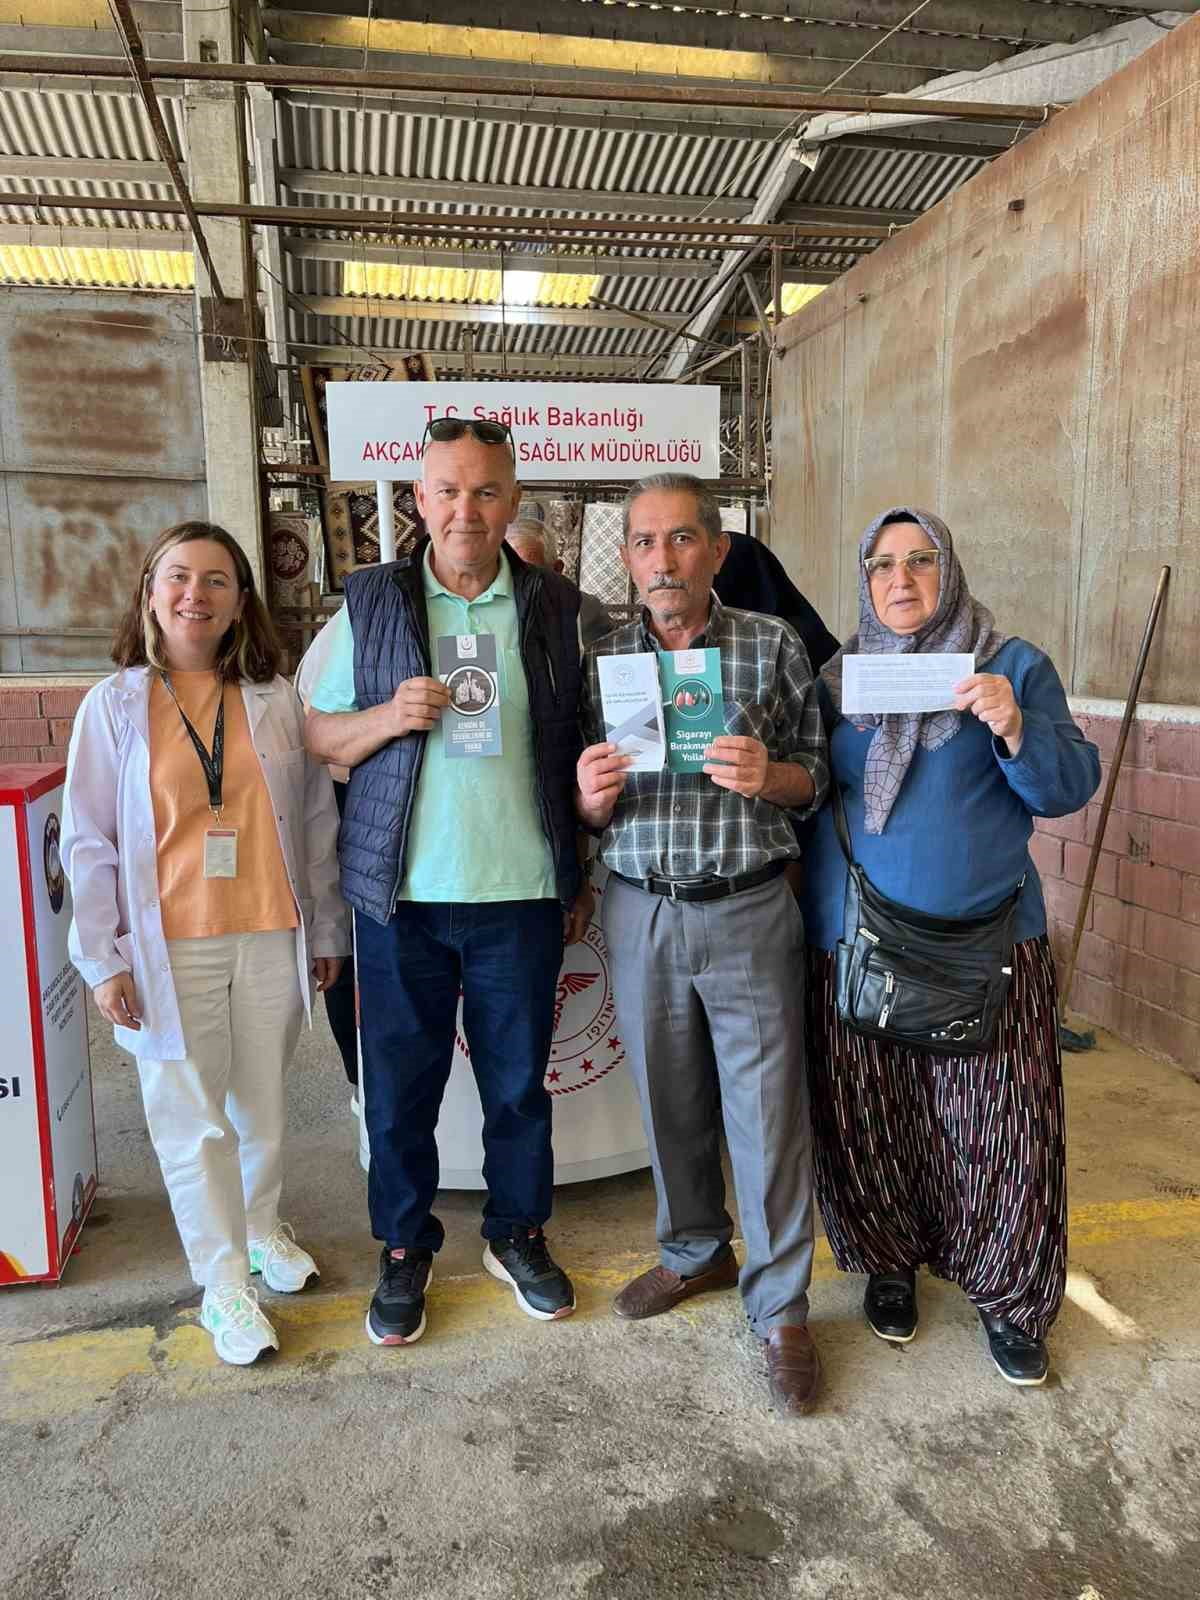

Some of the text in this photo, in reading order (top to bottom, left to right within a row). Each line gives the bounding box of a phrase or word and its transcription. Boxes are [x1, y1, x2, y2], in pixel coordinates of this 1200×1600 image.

[473, 405, 540, 428] Sağlık
[547, 406, 644, 432] Bakanlığı
[519, 438, 585, 462] SAĞLIK
[591, 438, 701, 462] MÜDÜRLÜĞÜ
[676, 730, 712, 740] Sigarayı
